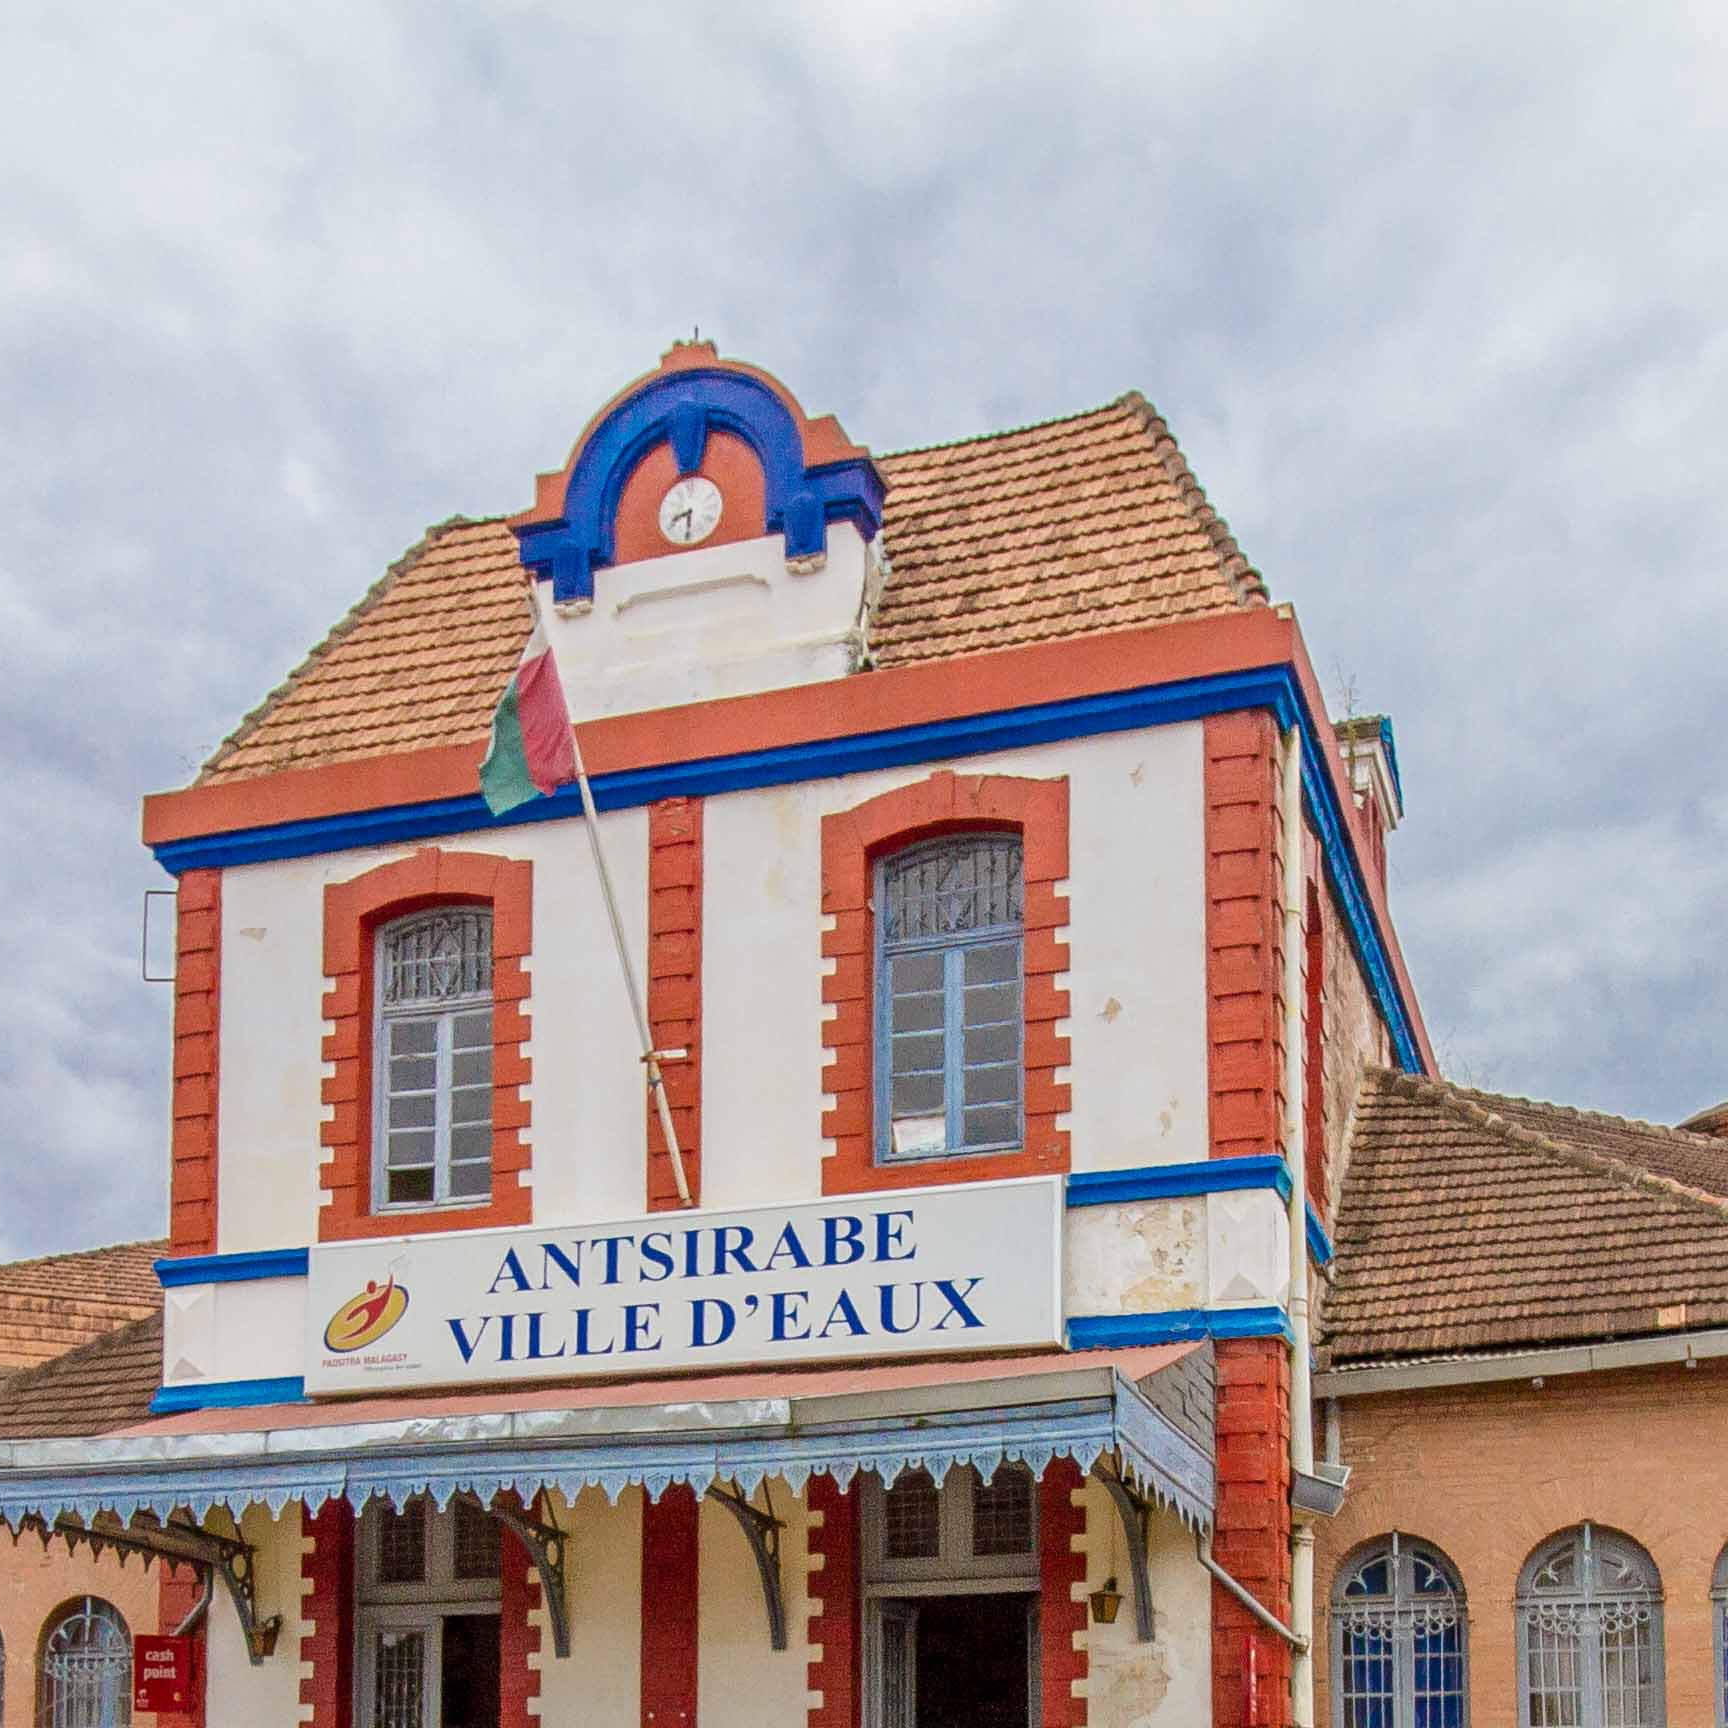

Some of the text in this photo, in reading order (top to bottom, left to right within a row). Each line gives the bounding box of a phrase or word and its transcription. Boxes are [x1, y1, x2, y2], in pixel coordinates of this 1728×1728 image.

[486, 1210, 918, 1295] ANTSIRABE
[446, 1277, 986, 1365] VILLE D'EAUX
[143, 1665, 177, 1681] point
[145, 1649, 175, 1662] cash
